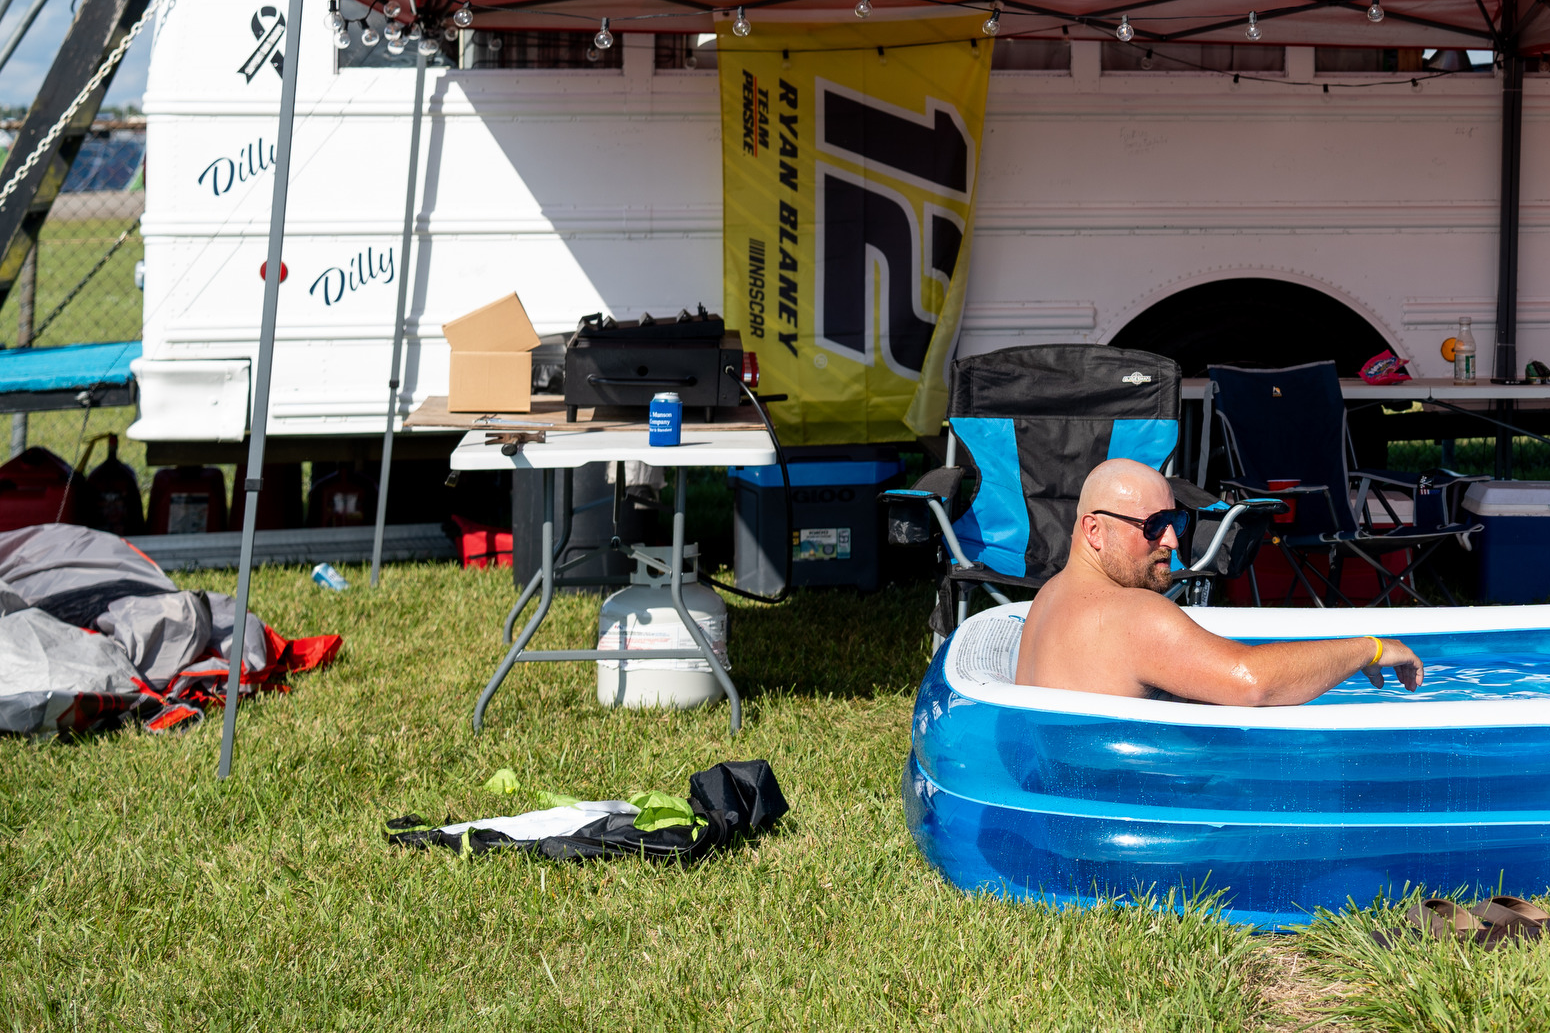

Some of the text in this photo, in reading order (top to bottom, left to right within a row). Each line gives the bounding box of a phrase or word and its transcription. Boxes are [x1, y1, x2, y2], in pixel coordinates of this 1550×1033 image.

[742, 68, 754, 156] PENSKE
[757, 88, 770, 150] TEAM
[778, 77, 799, 359] RYAN BLANEY
[814, 74, 977, 383] 12
[308, 246, 395, 307] Dilly
[748, 258, 765, 340] NASCAR
[792, 488, 856, 504] GLOO
